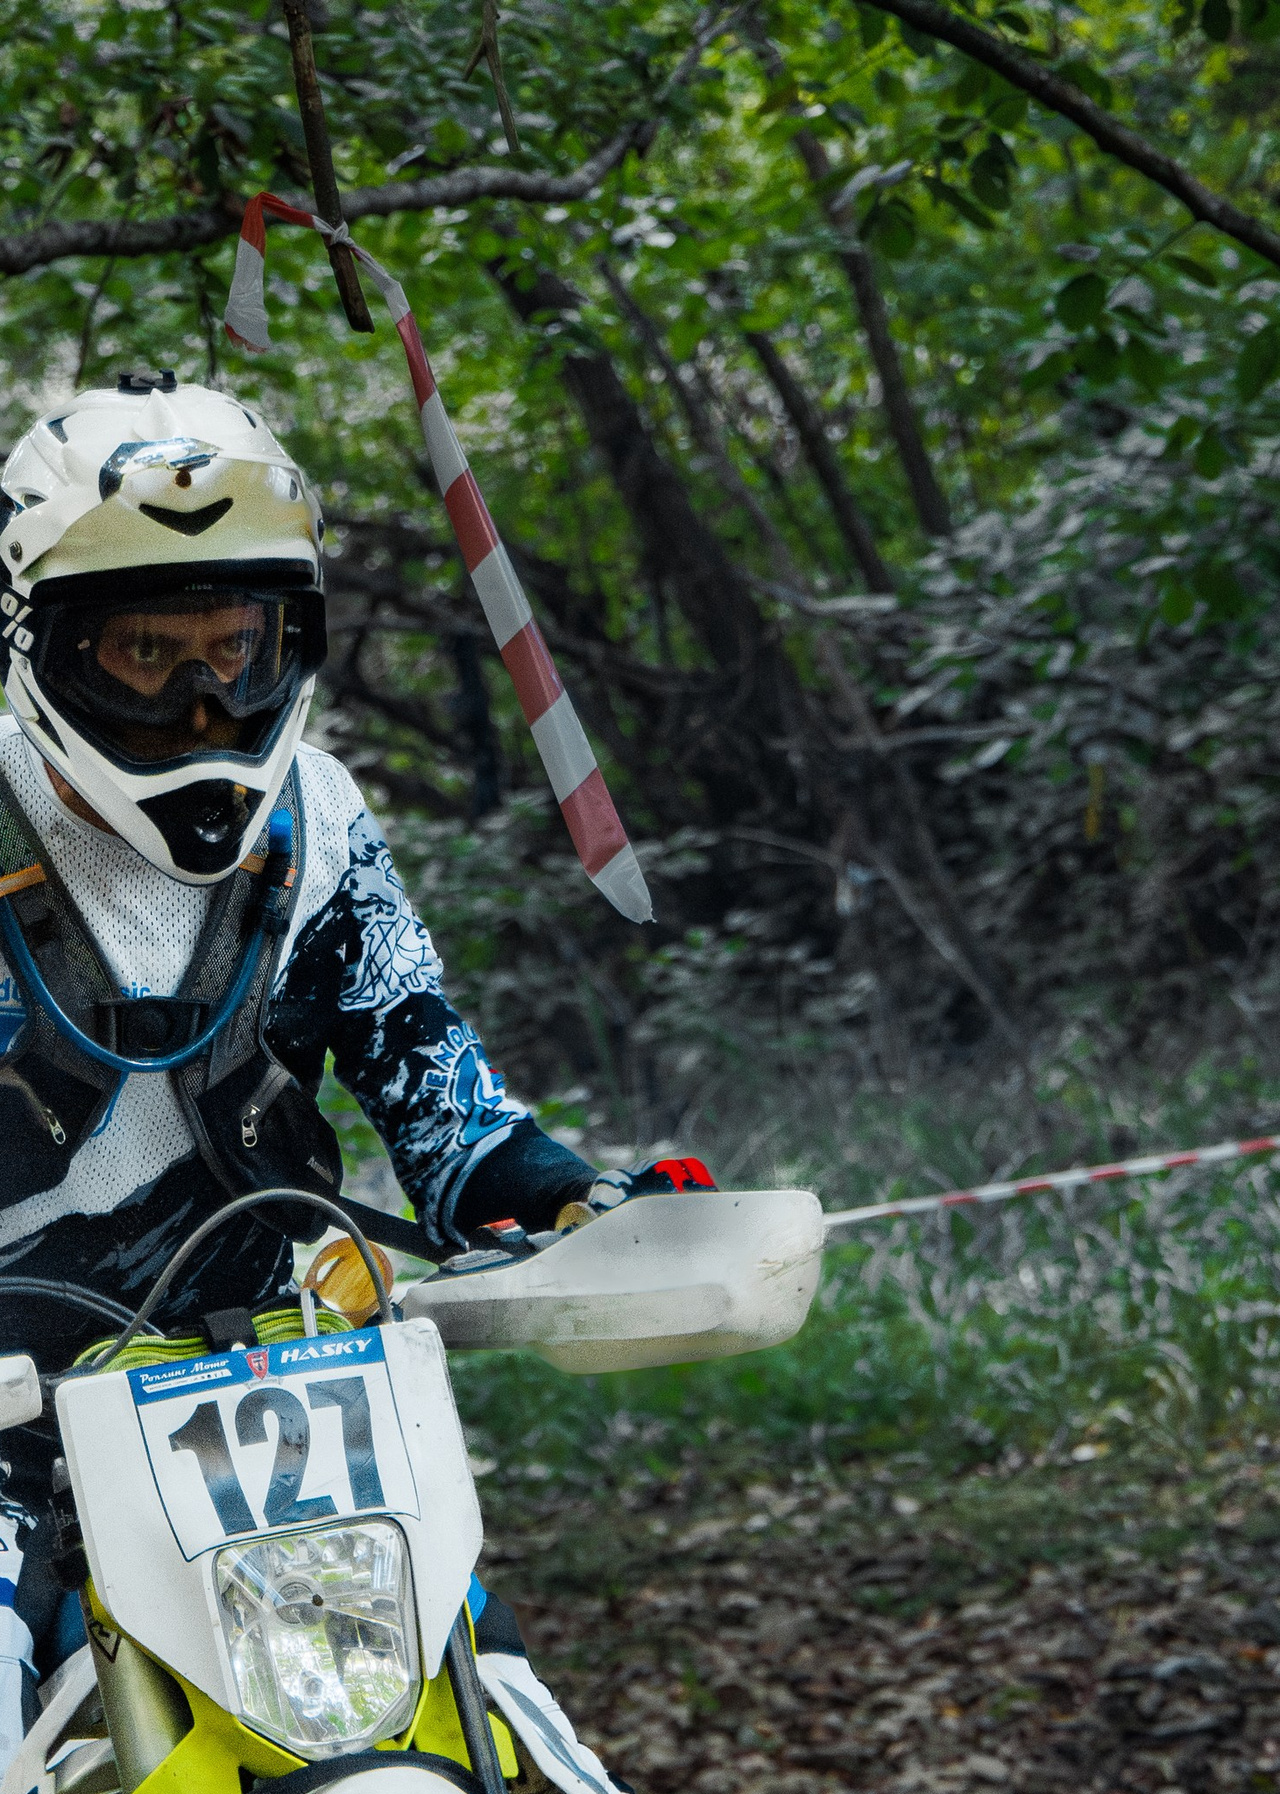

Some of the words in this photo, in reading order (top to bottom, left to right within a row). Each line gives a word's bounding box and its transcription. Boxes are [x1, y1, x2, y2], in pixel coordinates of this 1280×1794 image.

[280, 1338, 373, 1364] HASKY
[190, 1359, 230, 1374] Мото
[168, 1375, 386, 1536] 127
